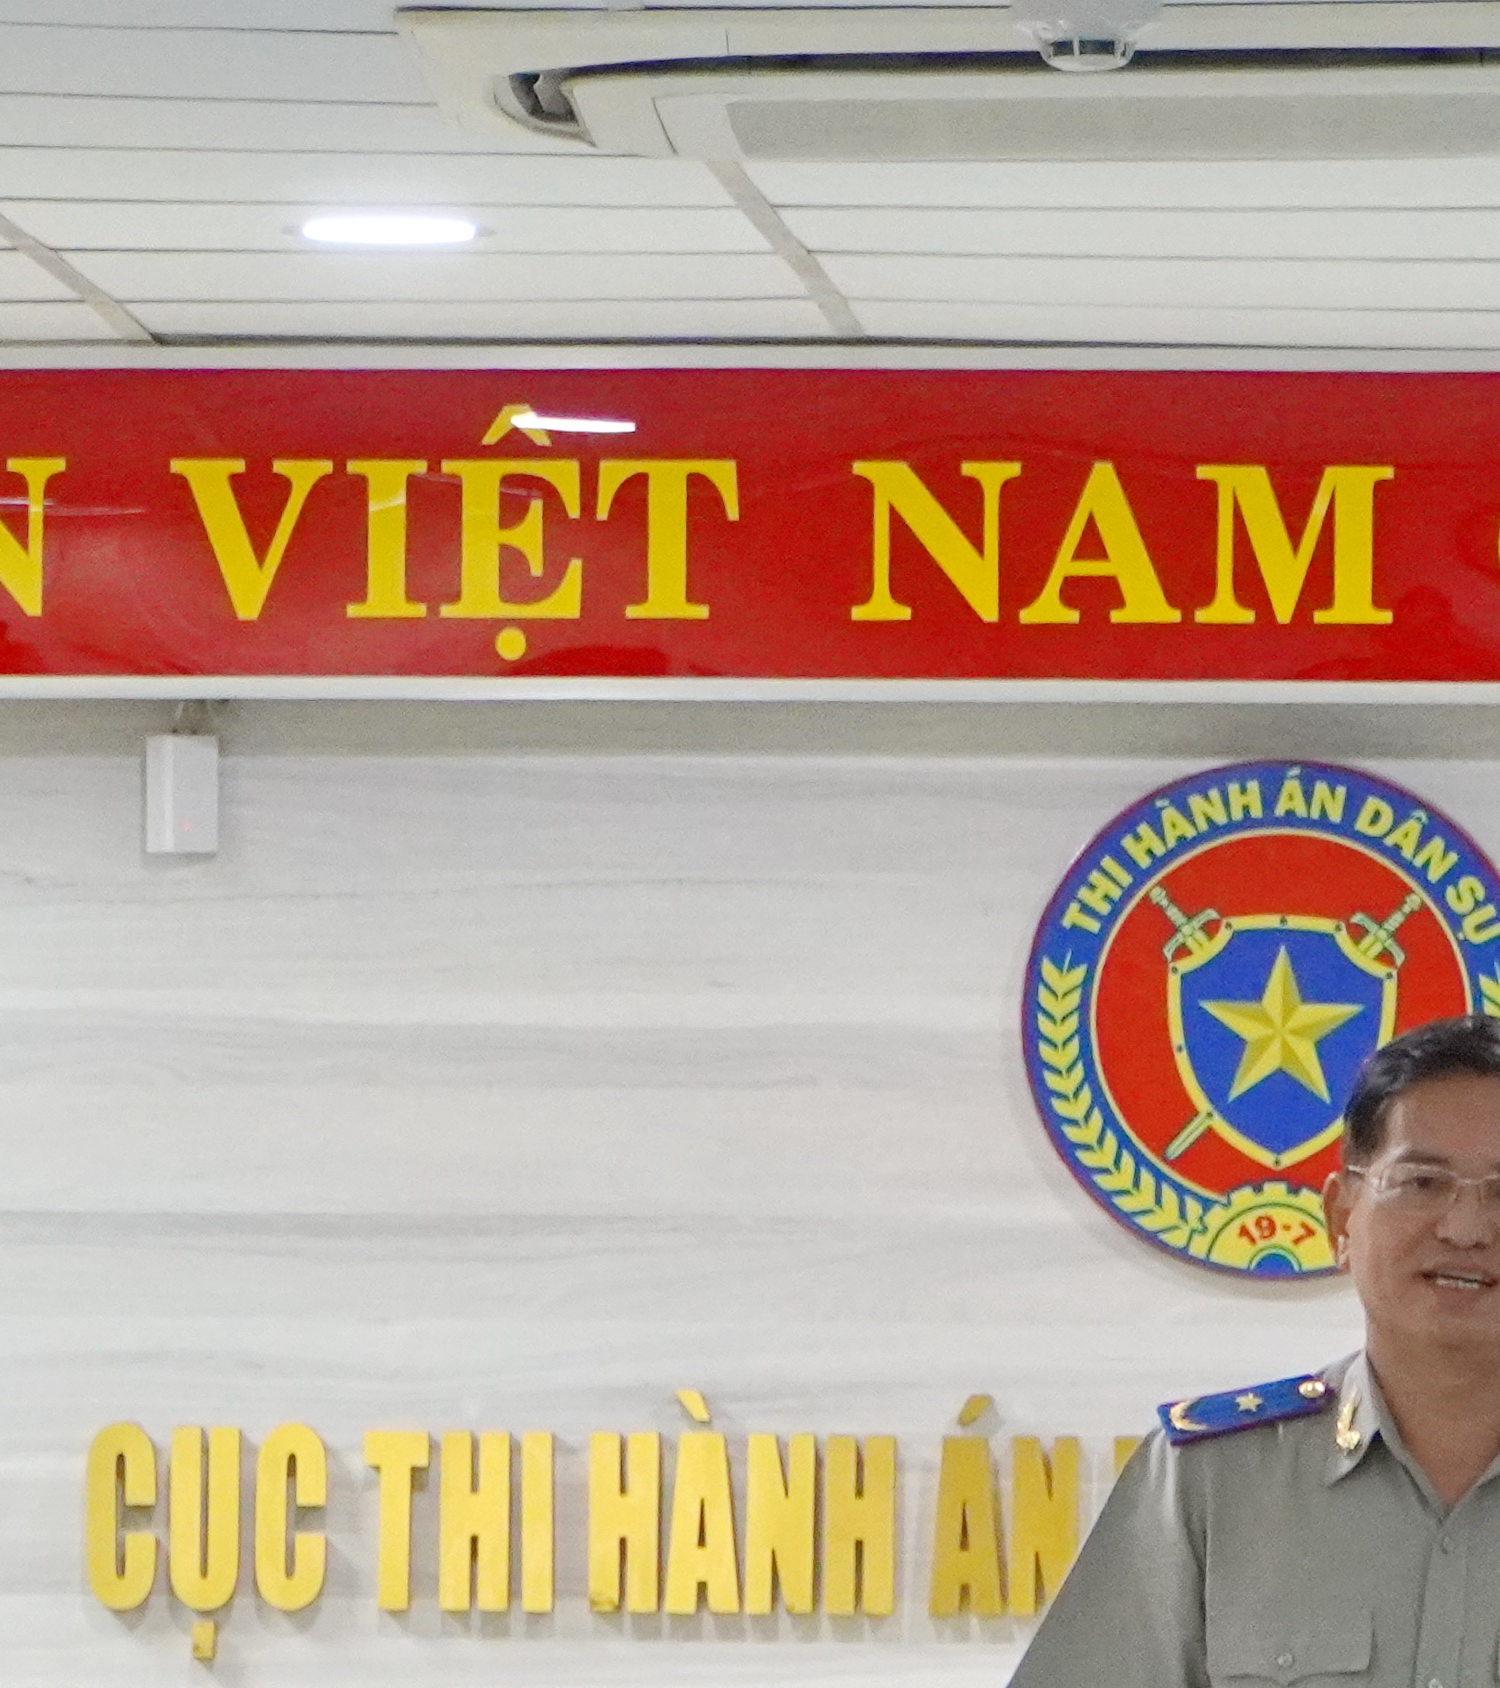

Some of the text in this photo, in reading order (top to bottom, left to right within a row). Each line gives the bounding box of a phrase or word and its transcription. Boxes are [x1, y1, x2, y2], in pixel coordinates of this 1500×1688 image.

[170, 405, 739, 660] VIỆT
[851, 460, 1394, 625] NAM
[1062, 853, 1134, 936] THI
[1120, 778, 1265, 870] HÀNH
[1275, 768, 1349, 825] ÁN
[1354, 797, 1459, 885] DÂN
[1238, 1214, 1316, 1246] 19-7
[86, 1423, 328, 1661] CỤC
[365, 1430, 556, 1614] THI
[589, 1390, 898, 1618] HÀNH
[928, 1394, 1079, 1617] ÁN
